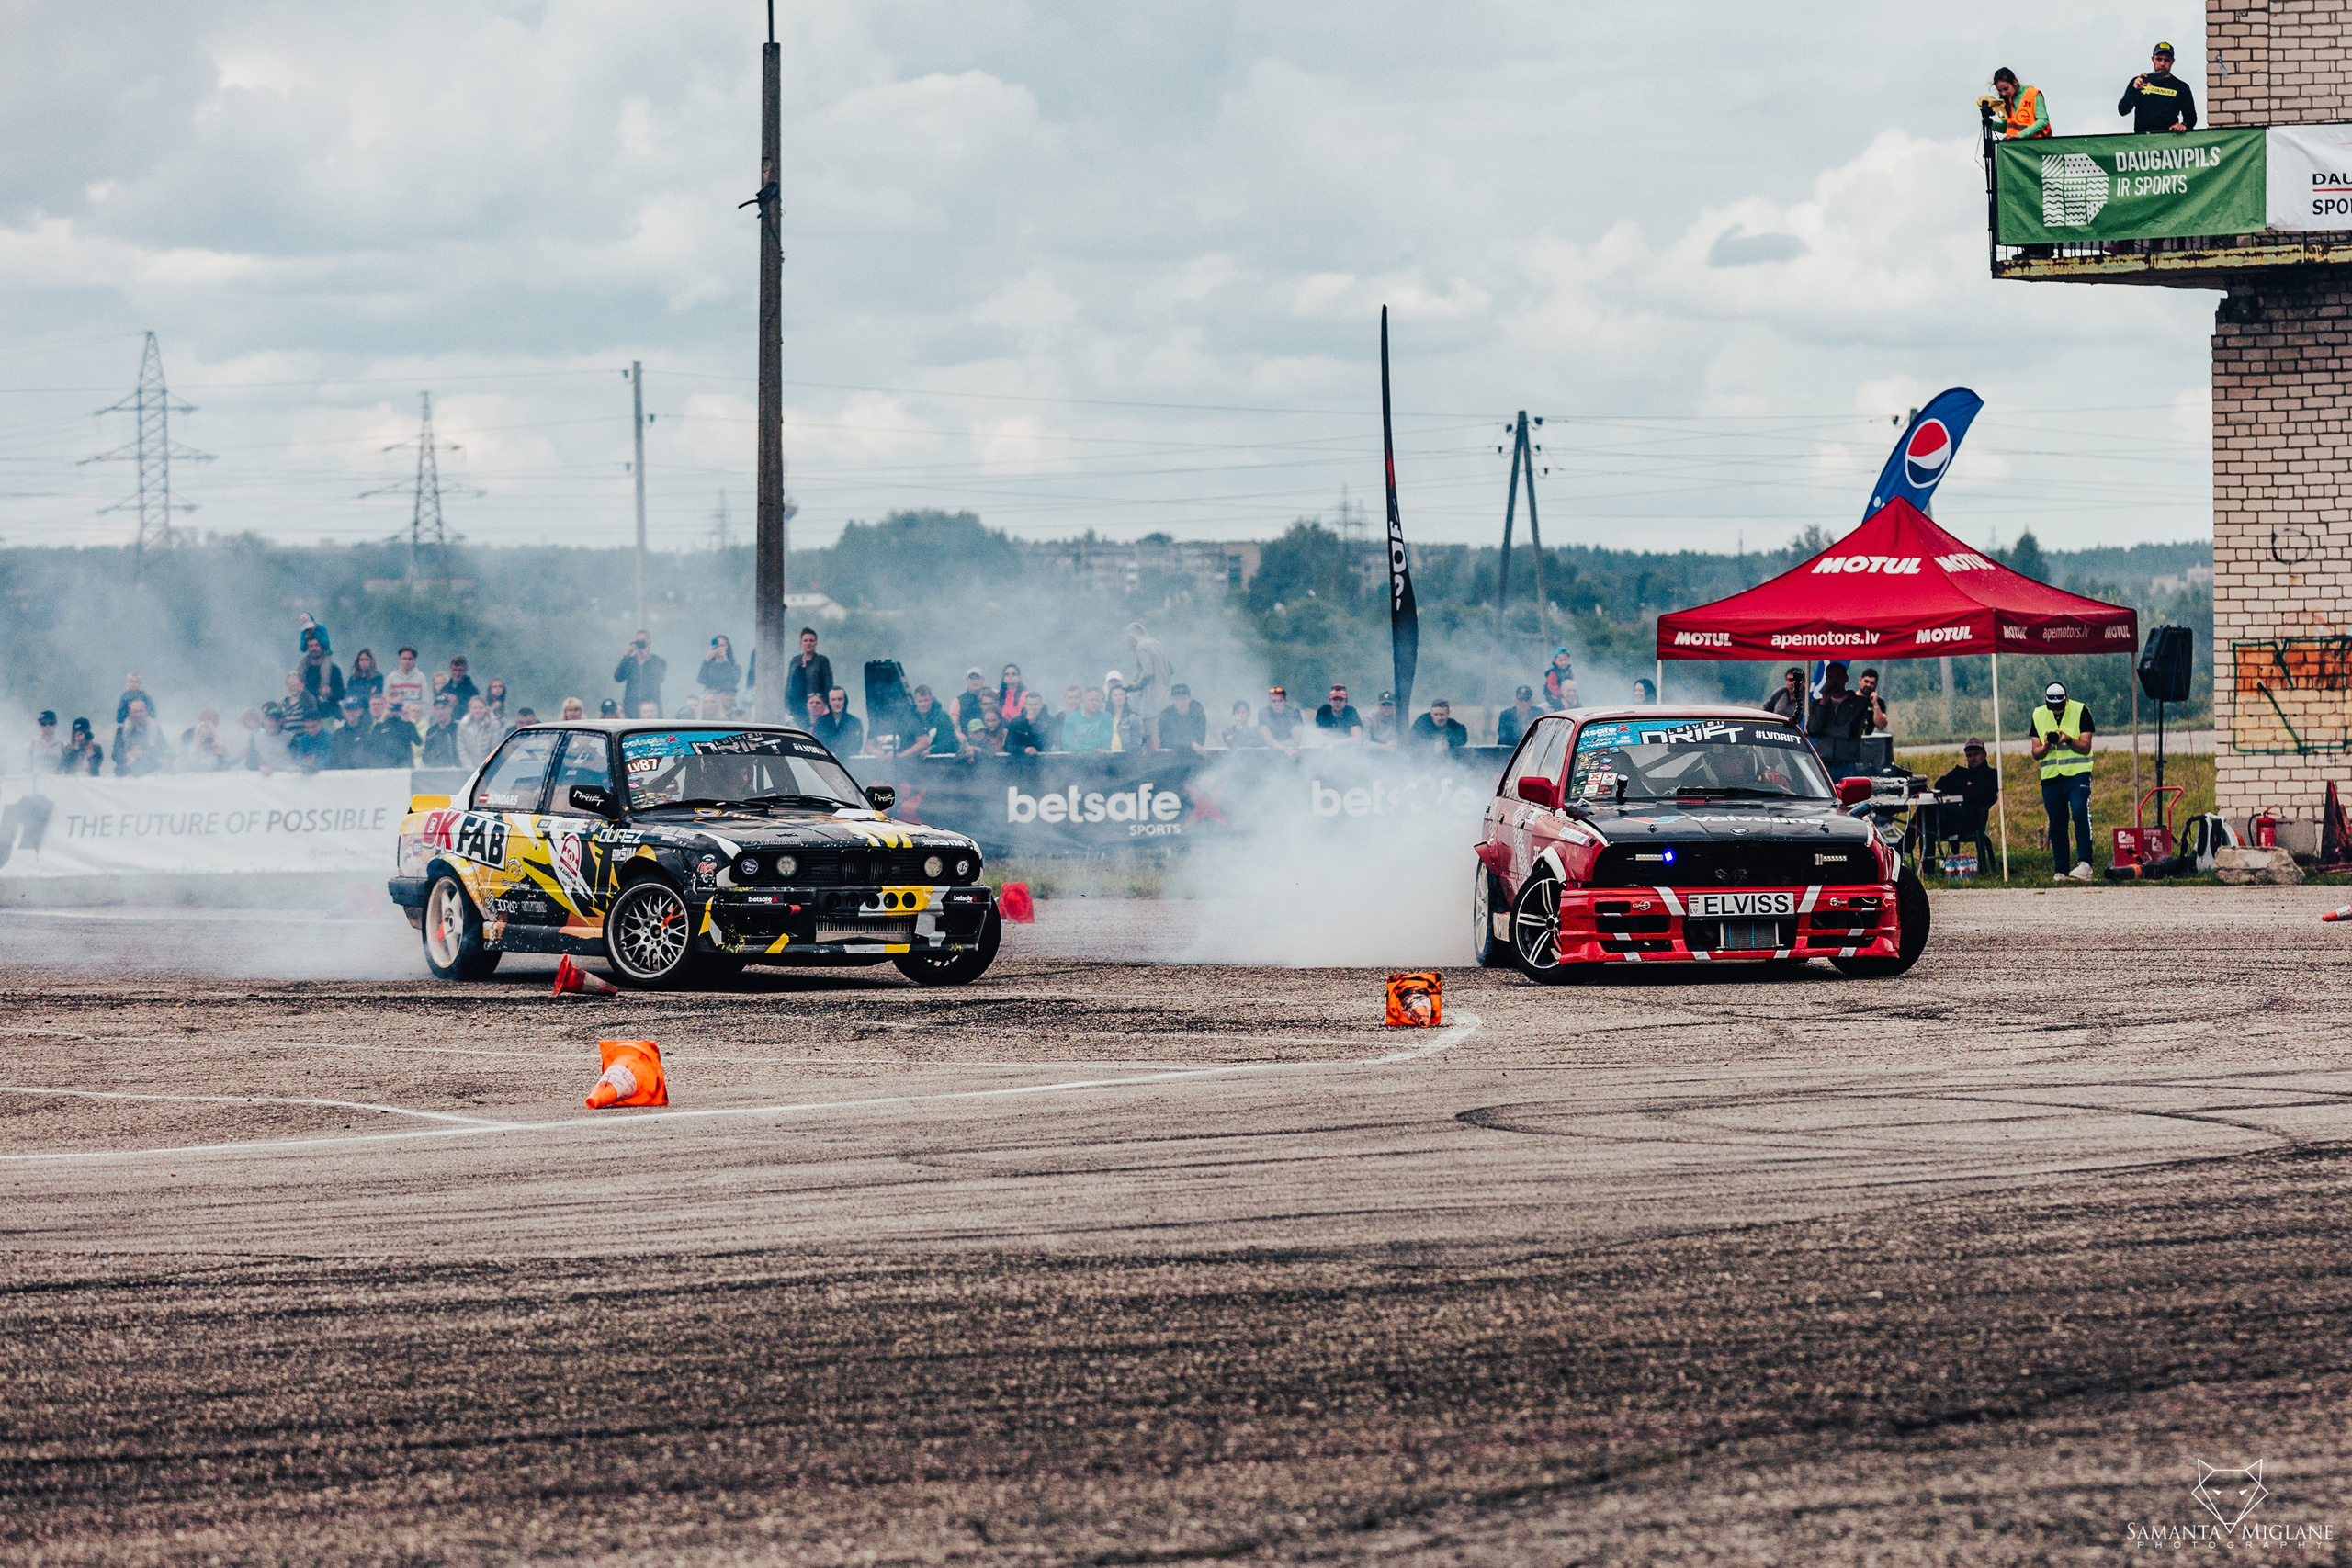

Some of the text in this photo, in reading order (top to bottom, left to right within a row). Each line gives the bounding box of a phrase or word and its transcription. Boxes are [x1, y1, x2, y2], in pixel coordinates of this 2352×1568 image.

[2115, 146, 2221, 172] DAUGAVPILS
[2117, 175, 2188, 197] IR SPORTS
[2312, 198, 2352, 215] SPO
[1811, 555, 1921, 574] MOTUL
[1934, 553, 1995, 572] MOTUL
[1674, 626, 1973, 649] MOTUL apemotors.lv MOTUL
[2003, 624, 2130, 642] MOTUL apemotors.lv MOTUL
[1641, 724, 1743, 744] DRIFT
[1755, 730, 1801, 744] #LVDRIFT
[627, 758, 657, 773] LV87
[487, 794, 519, 806] BONDARS
[1007, 783, 1182, 823] betsafe
[67, 807, 387, 838] THE FUTURE OF POSSIBLE
[1688, 816, 1824, 824] Valvoline
[423, 811, 505, 865] DK FAB
[1129, 824, 1181, 837] SPORTS
[1704, 895, 1790, 914] ELVISS
